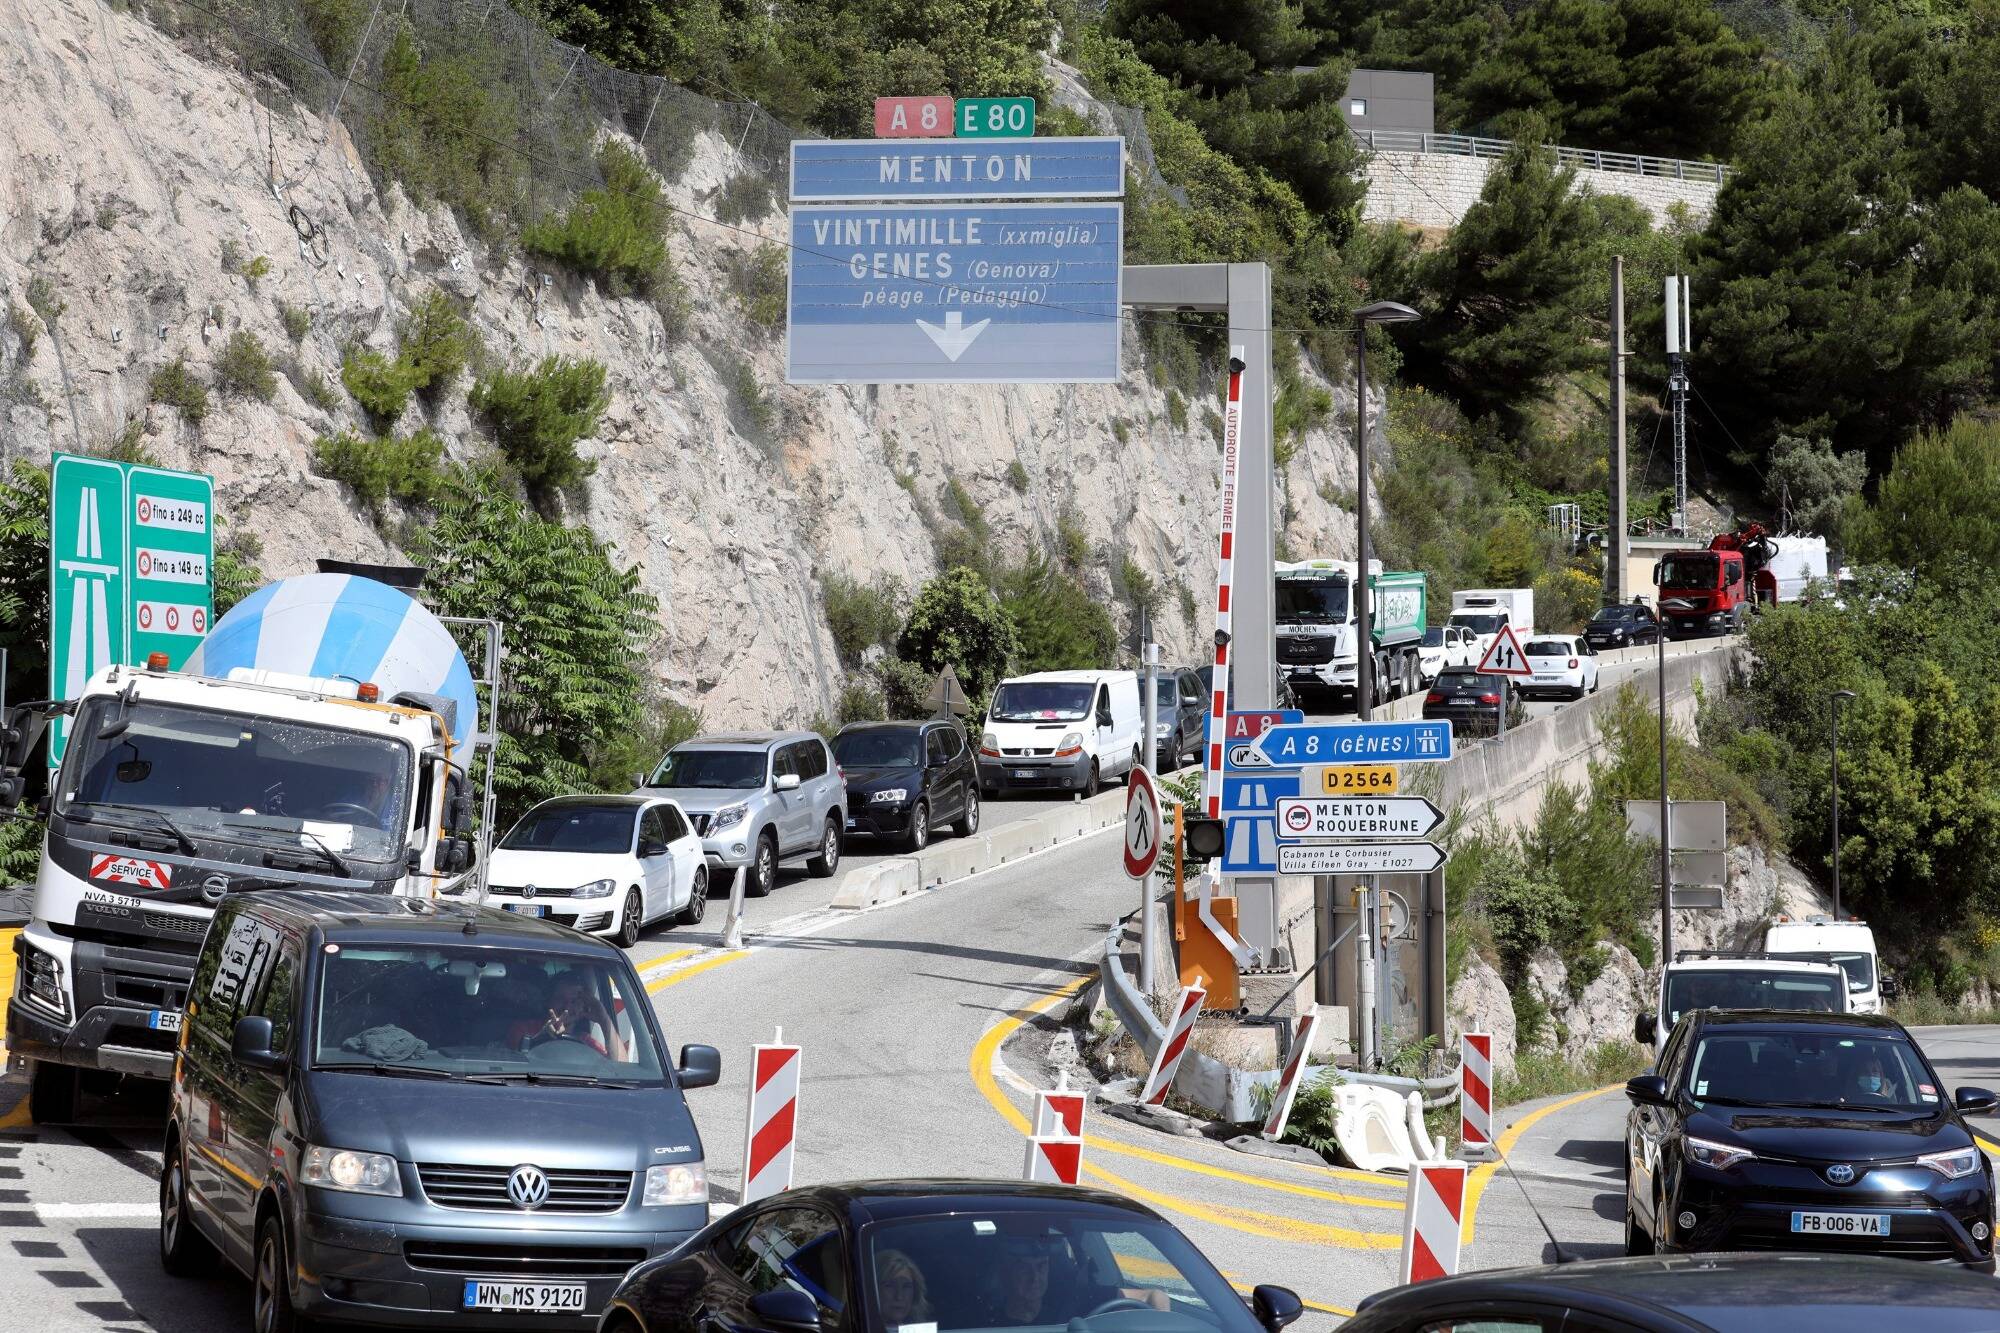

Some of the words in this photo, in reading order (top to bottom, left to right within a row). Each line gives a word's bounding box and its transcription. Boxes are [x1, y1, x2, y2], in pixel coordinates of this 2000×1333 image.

[890, 104, 908, 130] A
[920, 103, 939, 130] 8
[963, 104, 979, 131] E
[988, 104, 1026, 131] 80
[879, 154, 1032, 184] MENTON
[813, 217, 982, 246] VINTIMILLE
[999, 224, 1100, 248] (xxmiglia)
[850, 252, 953, 280] GENES
[967, 259, 1060, 280] (Genova)
[862, 286, 924, 309] péage
[938, 285, 1048, 308] (Pedaggio)
[1225, 408, 1237, 476] AUTOROUTE
[153, 505, 167, 519] fino
[170, 511, 175, 521] a
[177, 508, 193, 523] 249
[195, 515, 204, 525] cc
[1223, 484, 1234, 529] FERMEE
[153, 558, 168, 572] fino
[171, 564, 175, 574] a
[178, 560, 192, 575] 149
[195, 565, 203, 575] cc
[1234, 715, 1248, 737] A
[1260, 715, 1273, 733] 8
[1281, 737, 1297, 756] A
[1305, 736, 1319, 755] 8
[1334, 734, 1410, 755] (GÊNES)
[1343, 772, 1393, 788] 2564
[1316, 804, 1387, 816] MENTON
[1316, 820, 1419, 832] ROQUEBRUNE
[1283, 850, 1325, 859] Cabanon
[1330, 850, 1340, 859] Le
[1345, 849, 1392, 858] Corbusier
[110, 864, 152, 879] SERVICE
[1284, 861, 1306, 870] Villa
[1311, 860, 1342, 869] Eileen
[1346, 860, 1369, 871] Gray
[84, 891, 107, 903] NVA
[117, 897, 141, 908] 5719
[85, 904, 129, 916] VOLVO
[540, 1288, 583, 1307] 9120
